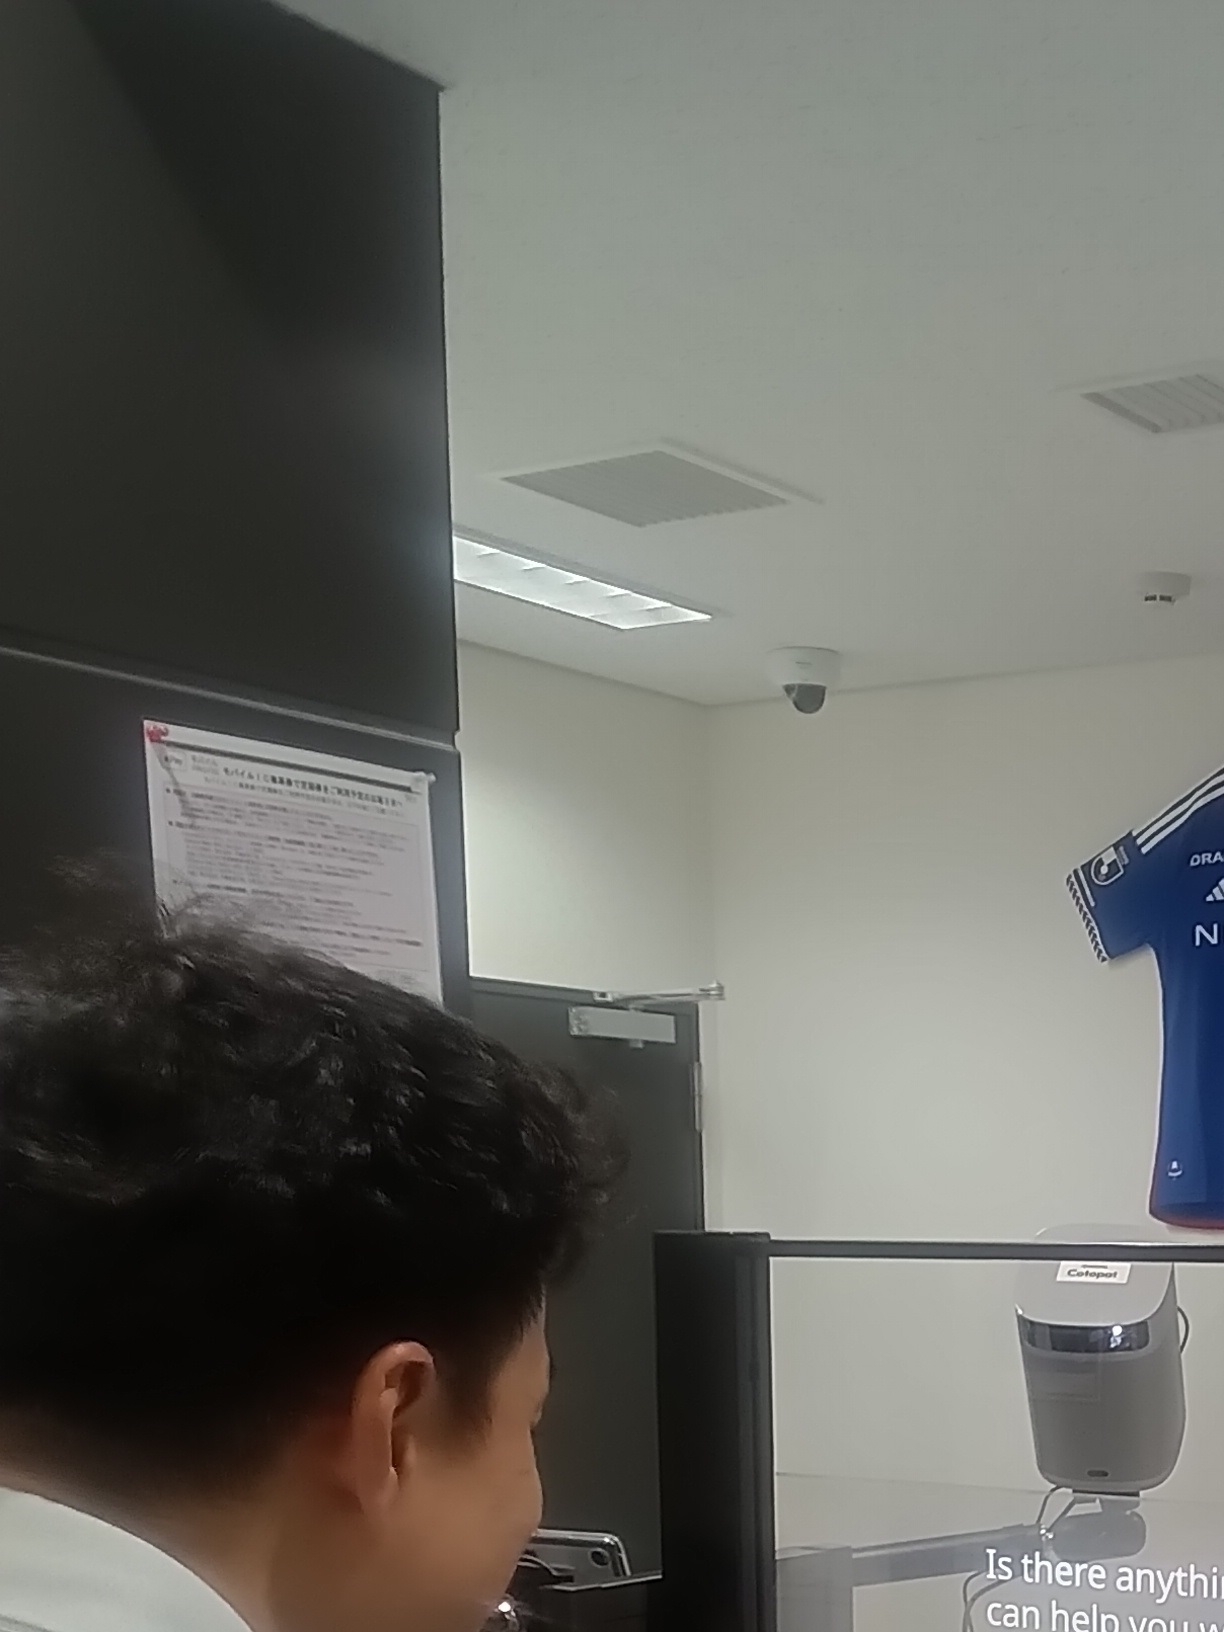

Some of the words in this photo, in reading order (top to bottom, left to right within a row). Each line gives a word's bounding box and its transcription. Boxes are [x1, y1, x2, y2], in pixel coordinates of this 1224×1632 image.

[985, 1547, 1013, 1581] Is
[1021, 1551, 1107, 1589] there
[986, 1602, 1040, 1630] can
